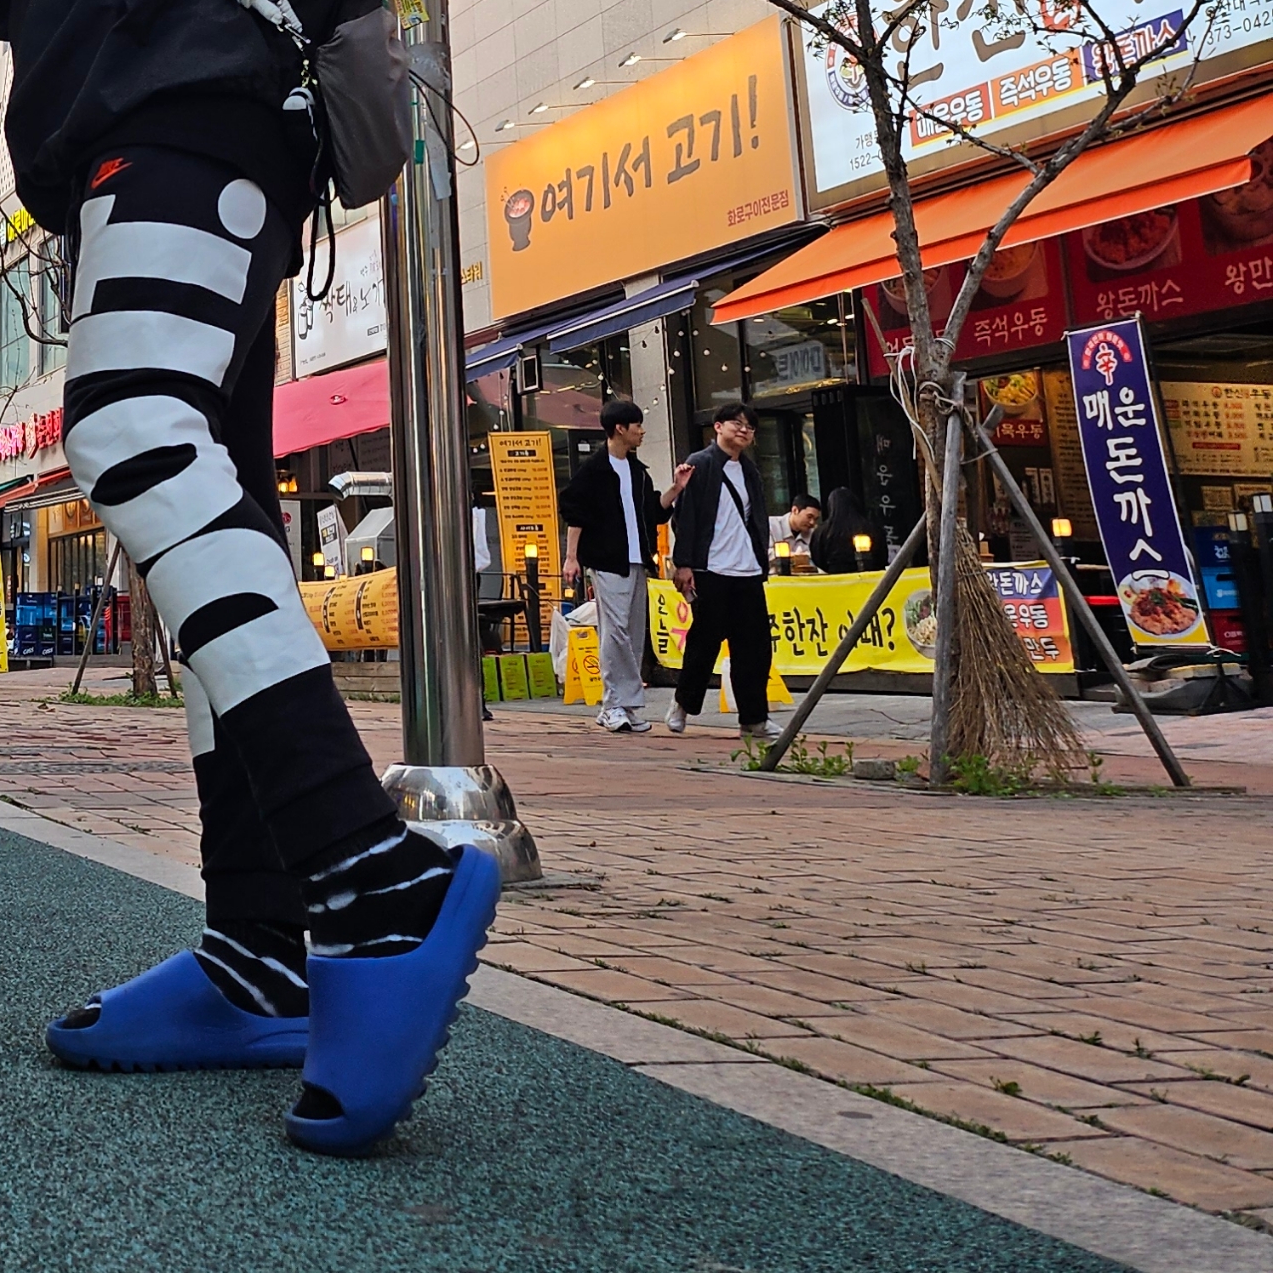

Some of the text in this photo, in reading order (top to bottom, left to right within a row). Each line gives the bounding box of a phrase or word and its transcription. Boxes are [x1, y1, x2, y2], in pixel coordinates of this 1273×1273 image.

[1206, 10, 1273, 46] 373-042
[999, 53, 1073, 109] 즉석우동
[915, 89, 984, 140] 매운우동
[540, 135, 653, 223] 여기서
[666, 74, 760, 185] 고기!
[727, 189, 789, 227] 화로구이전문점
[1096, 275, 1185, 317] 왕돈까스
[974, 308, 1048, 347] 즉석우동
[1082, 386, 1146, 430] 매운
[1104, 436, 1173, 582] 돈까스
[1003, 604, 1048, 628] 운우동
